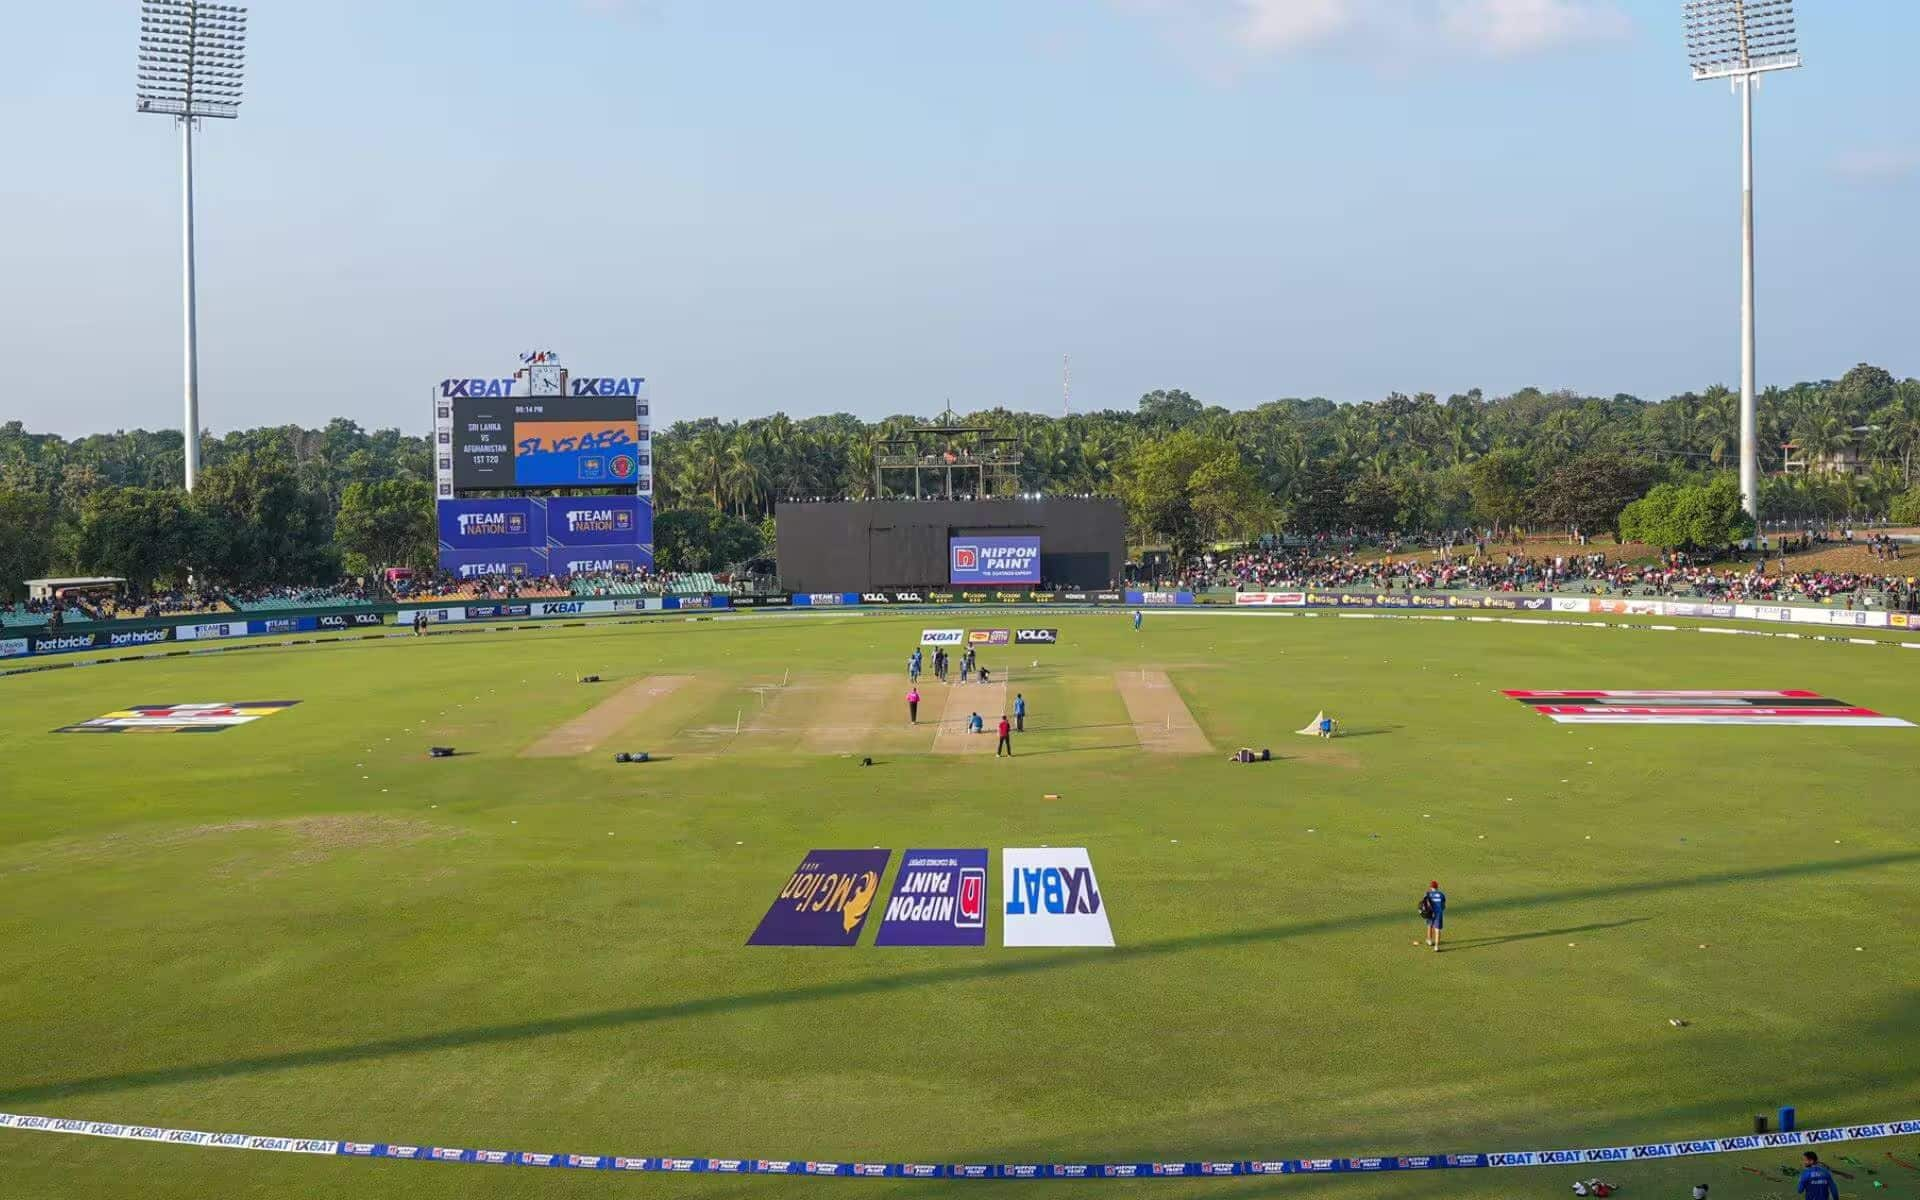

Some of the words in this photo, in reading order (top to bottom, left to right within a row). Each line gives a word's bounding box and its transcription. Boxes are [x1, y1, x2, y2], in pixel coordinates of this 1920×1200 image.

[440, 379, 516, 397] 1XBAT
[571, 378, 645, 396] 1XBAT
[468, 423, 479, 432] SRI
[480, 423, 501, 432] LANKA
[463, 444, 507, 453] AFGHANISTAN
[473, 455, 485, 464] 1ST
[486, 455, 499, 464] T20
[466, 524, 504, 535] NATION
[575, 521, 612, 531] NATION
[981, 547, 1037, 558] NIPPON
[987, 558, 1031, 569] PAINT
[542, 602, 584, 614] 1XBAT
[923, 633, 961, 641] 1XBAT
[901, 872, 951, 893] PAINT
[1006, 866, 1102, 914] 1XBAT
[885, 896, 954, 921] NIPPON
[17, 1117, 51, 1128] 1XBAT
[55, 1119, 89, 1132] 1XBAT
[91, 1123, 126, 1136] 1XBAT
[129, 1127, 167, 1139] 1XBAT
[169, 1131, 207, 1144] 1XBAT
[210, 1133, 250, 1145] 1XBAT
[252, 1137, 292, 1149] 1XBAT
[295, 1140, 336, 1152] 1XBAT
[1489, 1153, 1532, 1166] 1XBAT
[1538, 1150, 1581, 1163] 1XBAT
[1586, 1148, 1628, 1160] 1XBAT
[1632, 1145, 1673, 1157] 1XBAT
[1677, 1141, 1716, 1154] 1XBAT
[1721, 1137, 1760, 1150] 1XBAT
[1764, 1133, 1802, 1145] 1XBAT
[1806, 1129, 1845, 1142] 1XBAT
[1848, 1126, 1886, 1138] 1XBAT
[1890, 1121, 1920, 1134] 1XBA
